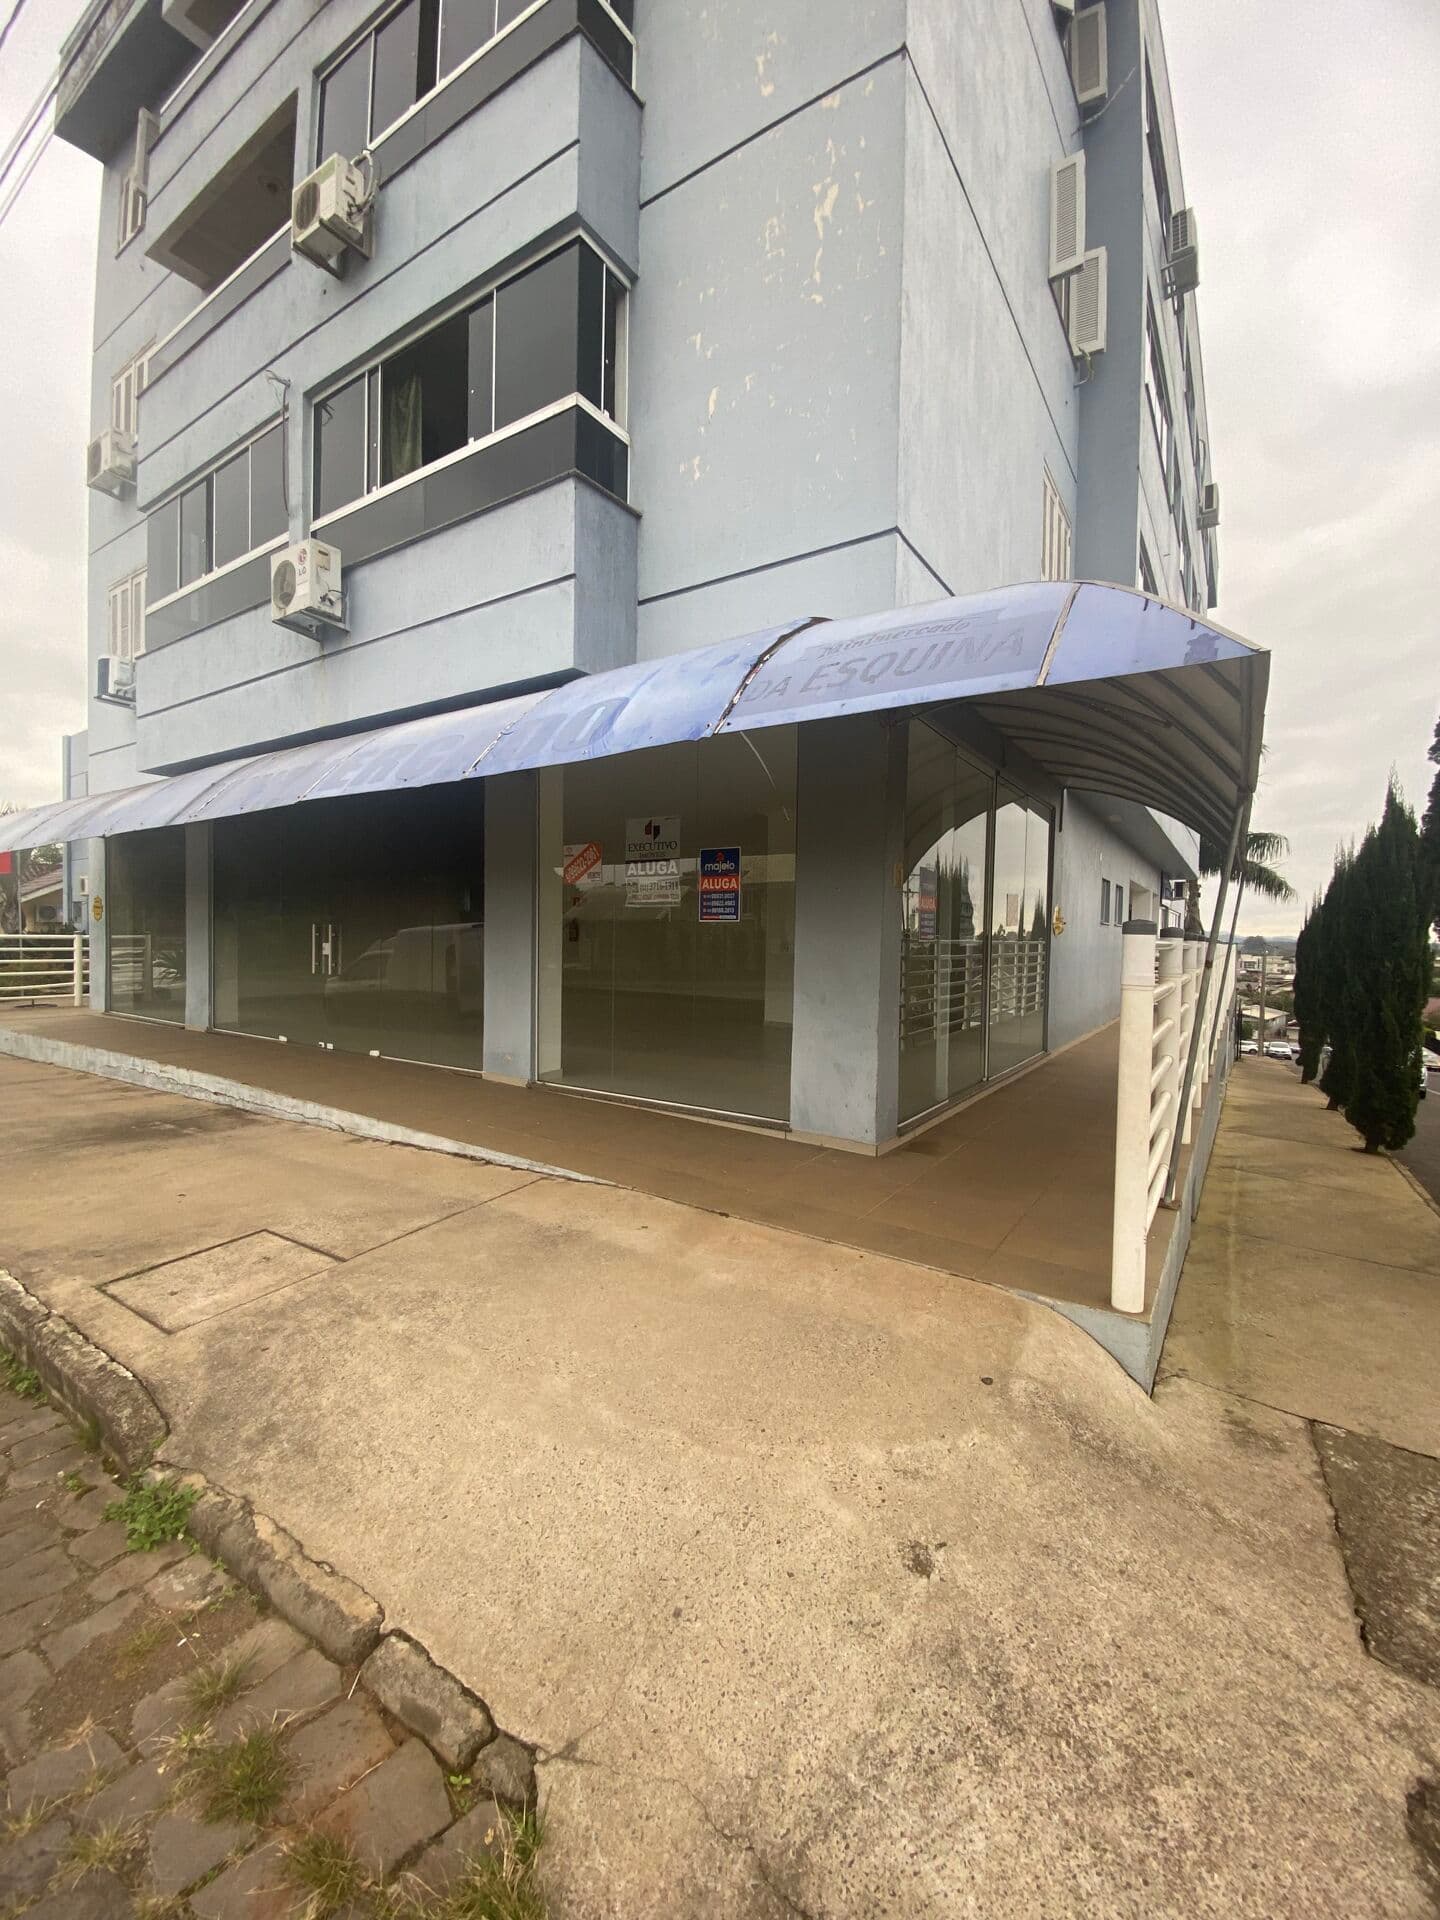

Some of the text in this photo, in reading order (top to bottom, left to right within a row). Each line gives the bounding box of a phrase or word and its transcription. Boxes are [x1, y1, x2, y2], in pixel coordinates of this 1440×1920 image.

[799, 626, 1025, 693] ESQUINA
[628, 840, 677, 851] EXECUTIVO
[627, 860, 678, 876] ALUGA
[702, 878, 738, 890] ALUGA
